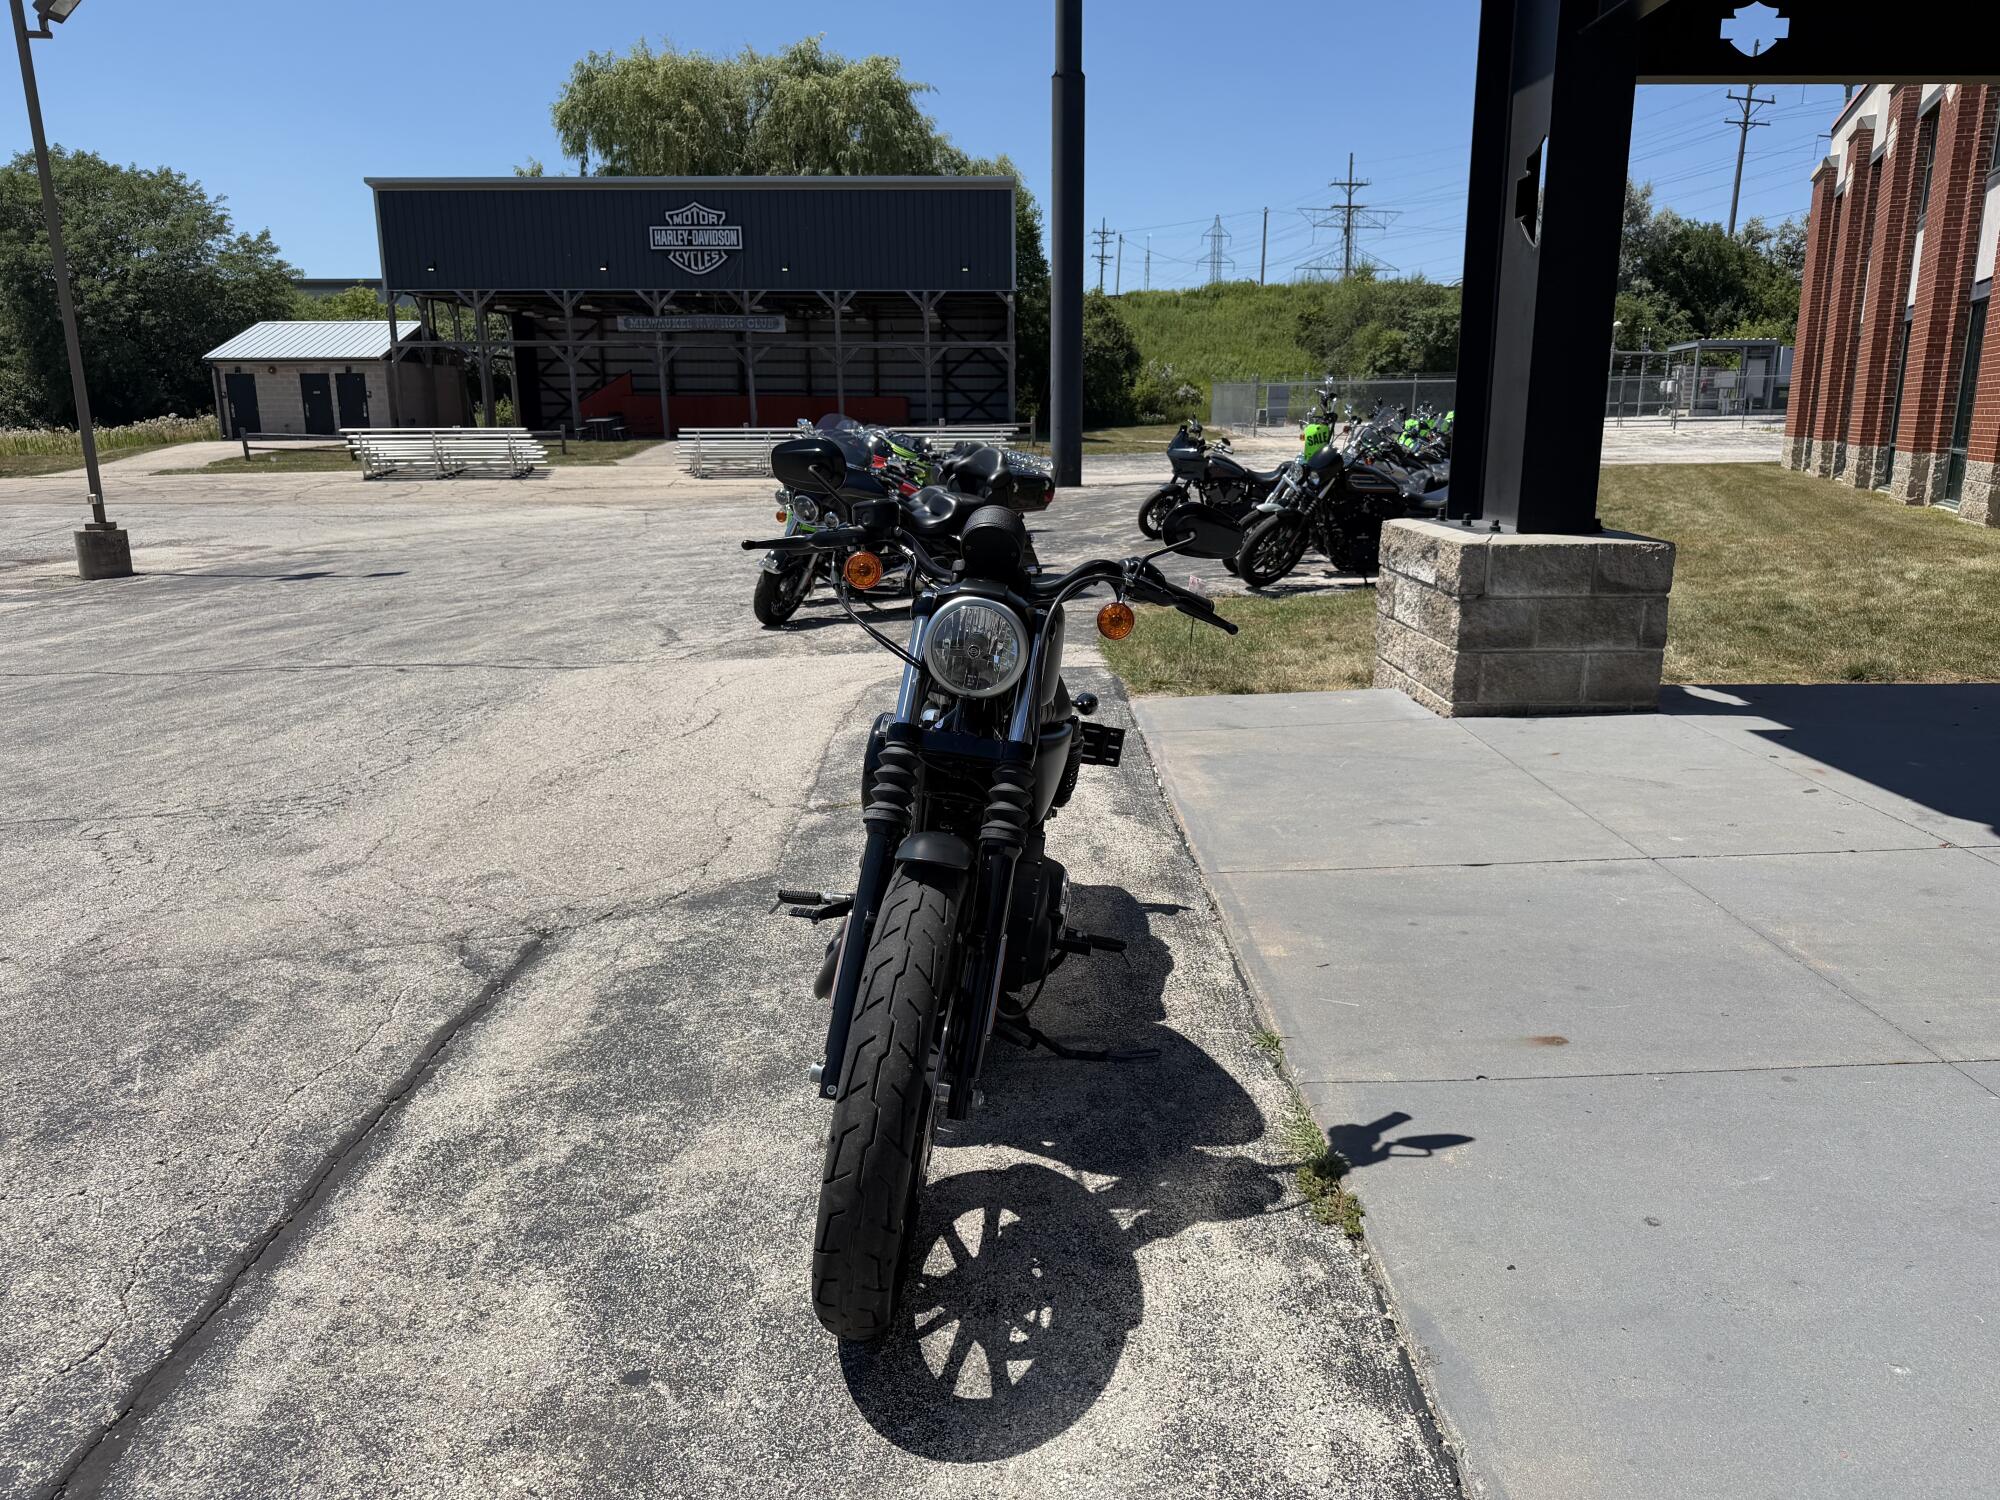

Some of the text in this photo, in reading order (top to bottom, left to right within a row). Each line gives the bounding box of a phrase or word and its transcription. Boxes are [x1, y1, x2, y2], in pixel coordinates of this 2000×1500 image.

[673, 207, 718, 225] MOTOR
[654, 230, 737, 246] HARLEY-DAVIDSON
[675, 251, 719, 271] CYCLES
[629, 318, 692, 329] MILWAUKEE
[1307, 432, 1327, 446] SALE
